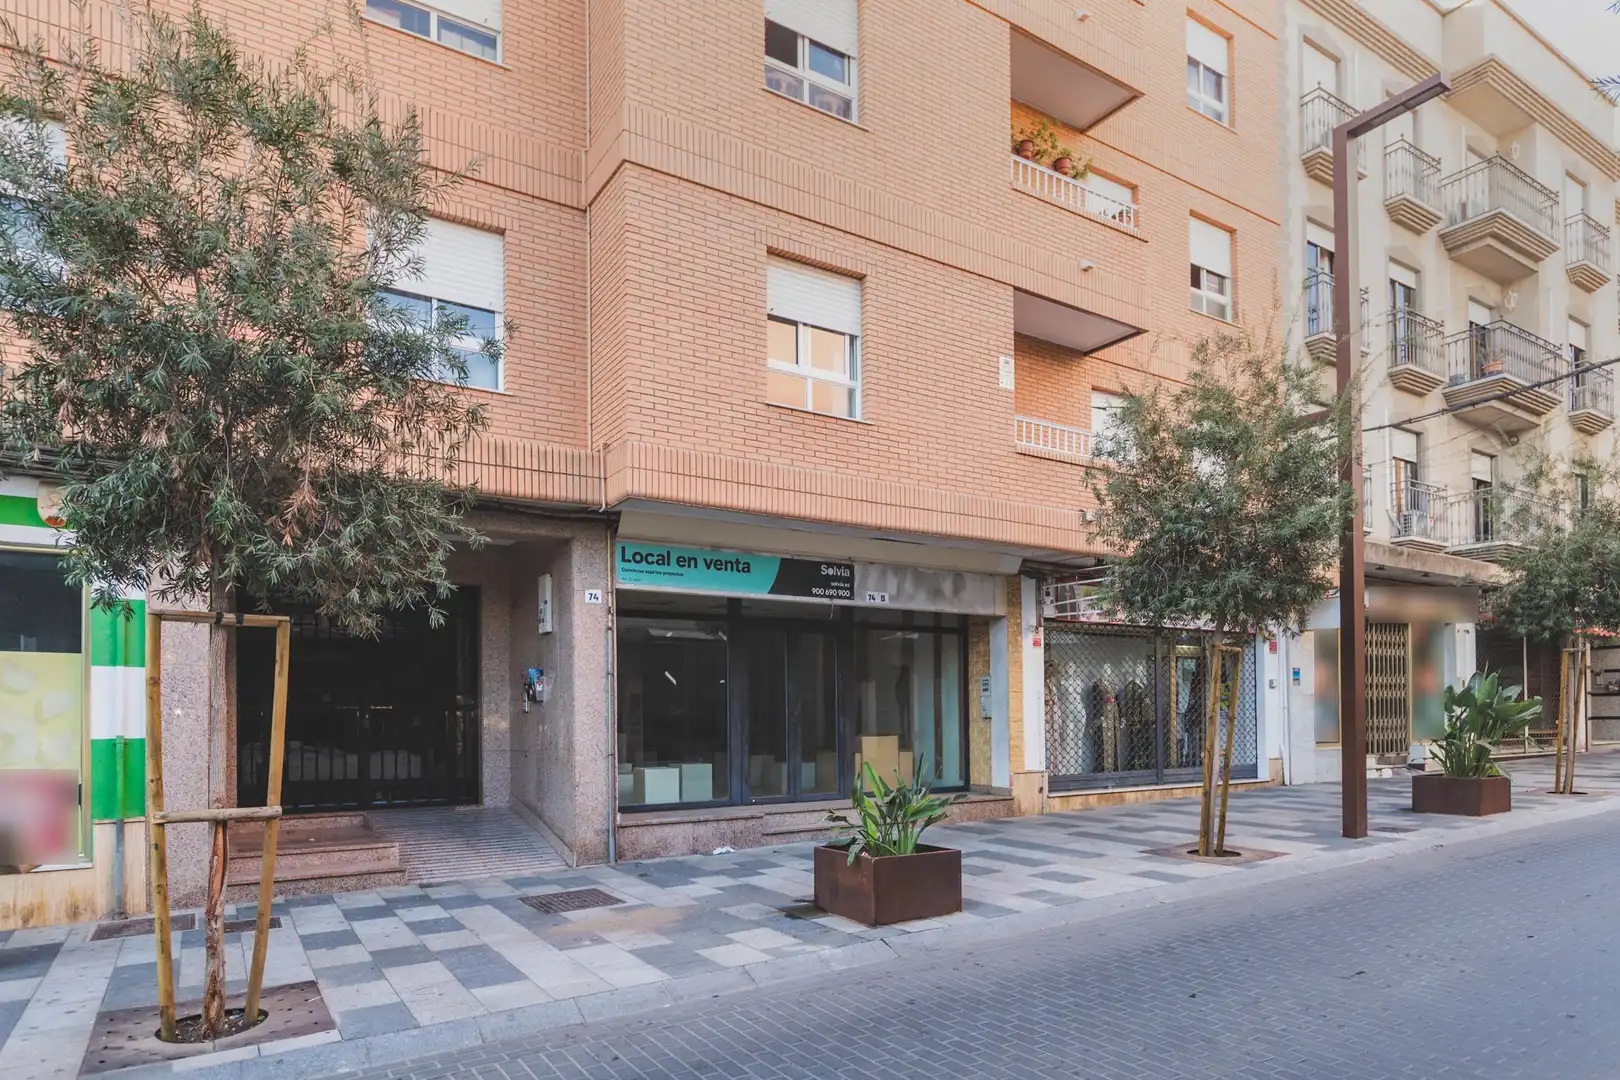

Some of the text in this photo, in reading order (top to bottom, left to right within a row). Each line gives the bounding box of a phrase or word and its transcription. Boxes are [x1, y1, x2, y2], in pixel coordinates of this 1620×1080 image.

[621, 546, 751, 574] Local en venta
[621, 567, 645, 575] Construye
[821, 565, 850, 577] Solvia
[588, 592, 599, 601] 74
[811, 587, 850, 597] 900 690 900
[868, 594, 876, 602] 74
